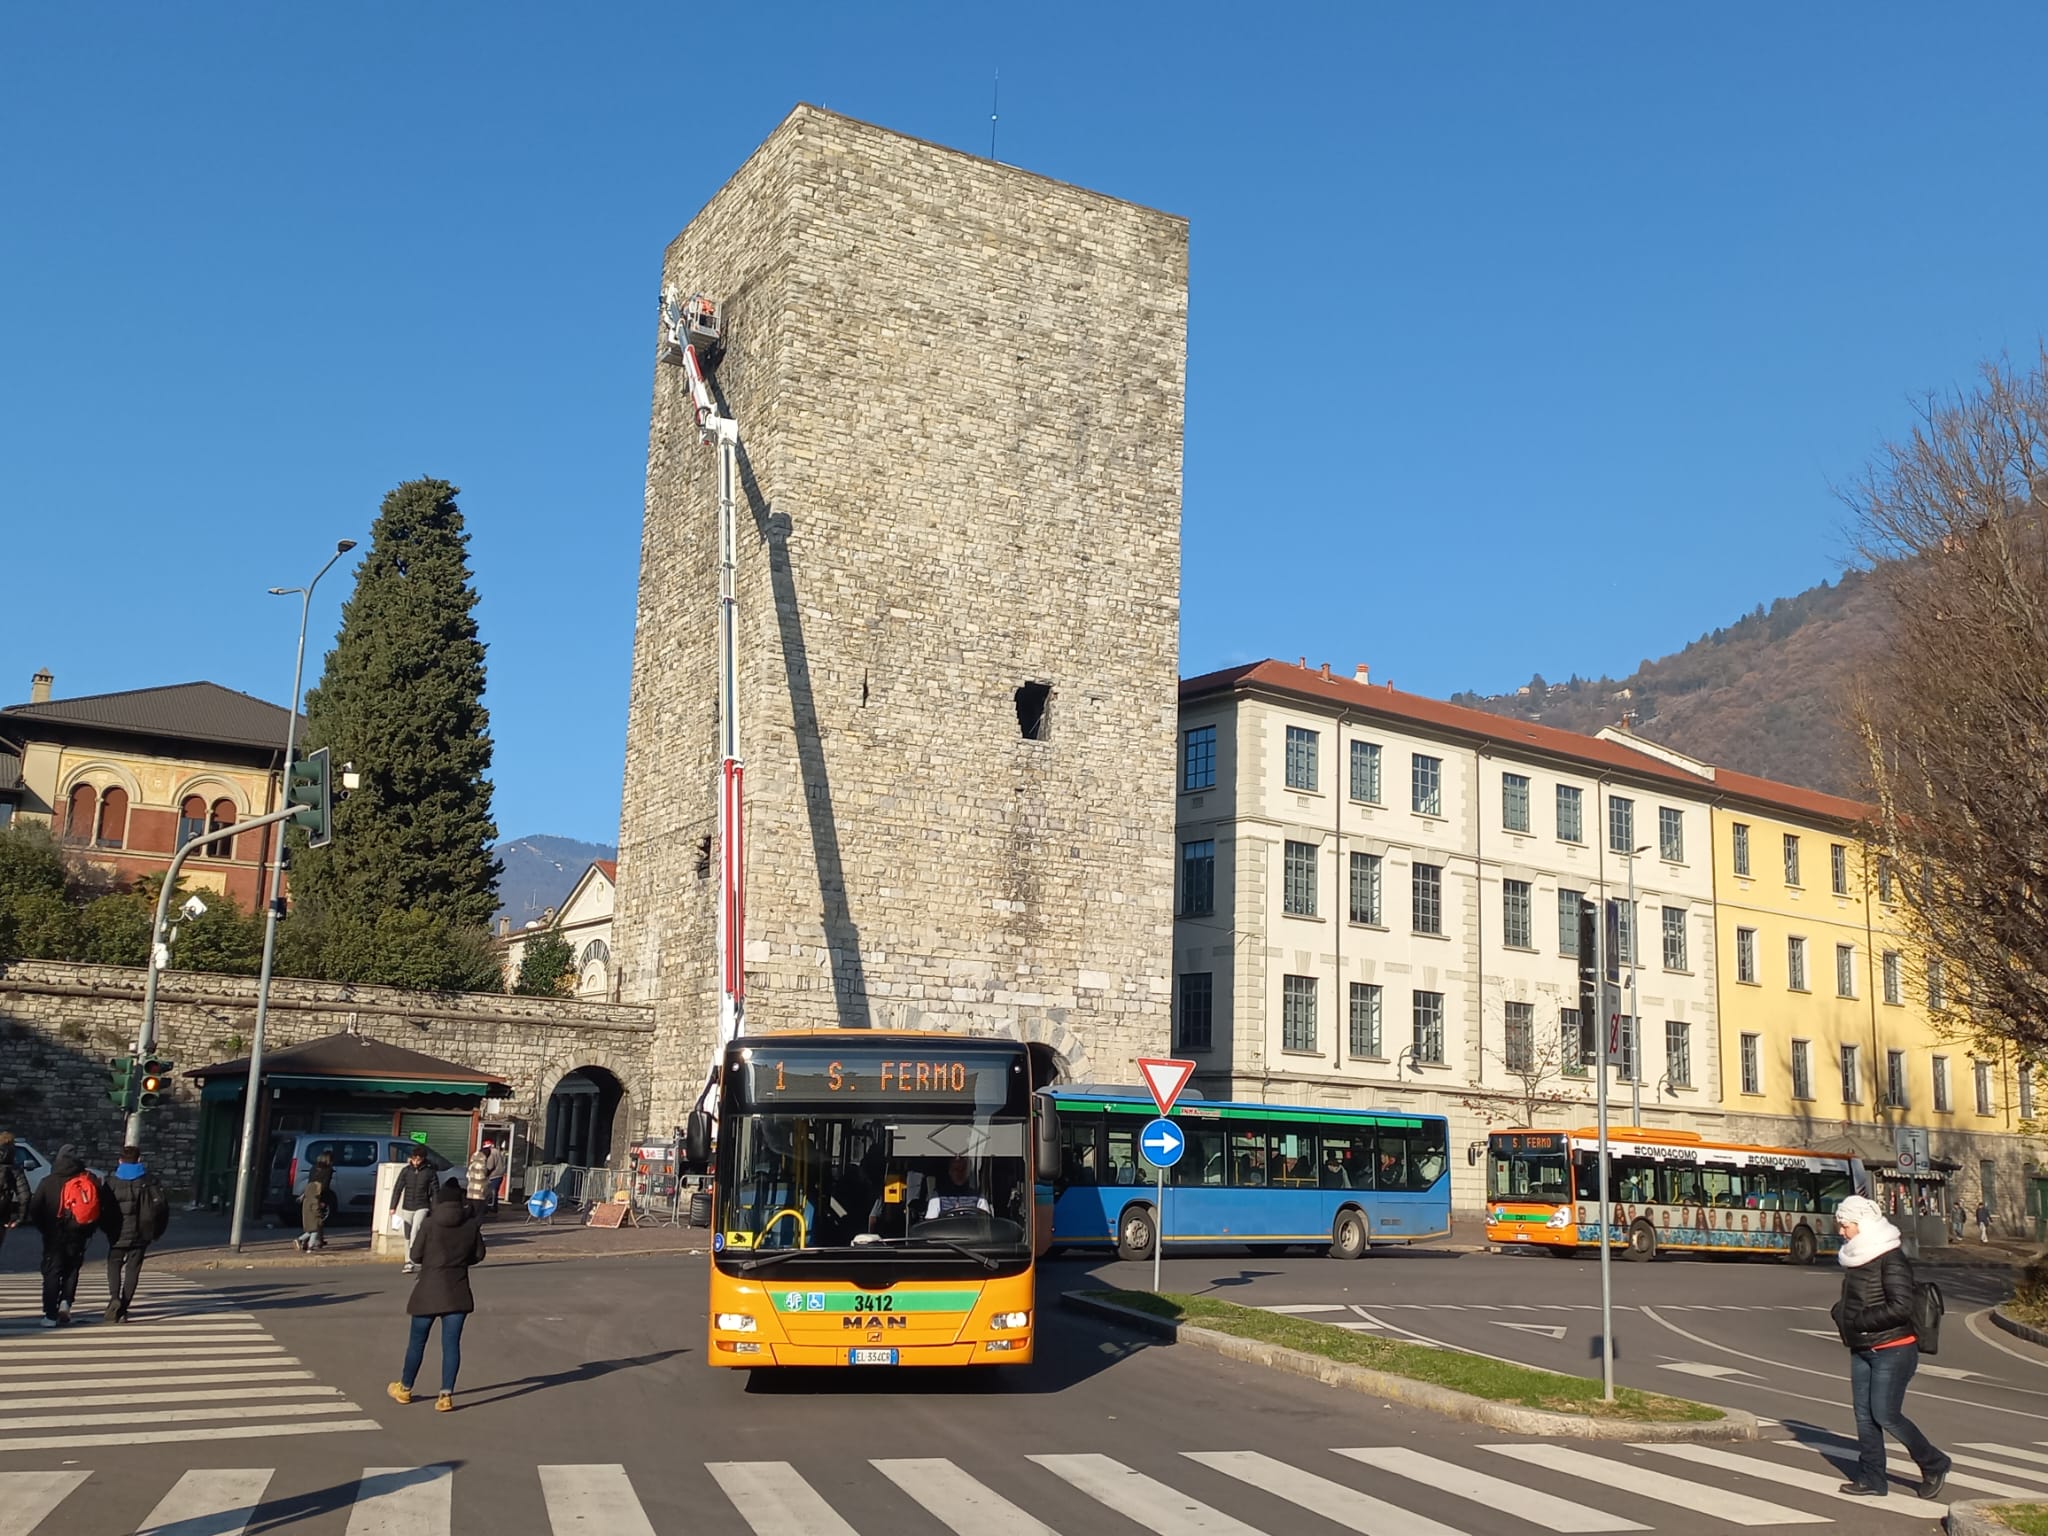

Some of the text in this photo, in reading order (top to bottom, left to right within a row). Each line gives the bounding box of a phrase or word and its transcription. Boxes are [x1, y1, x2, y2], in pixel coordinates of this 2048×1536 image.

[775, 1060, 966, 1091] 1 S. FERMO
[1526, 1136, 1552, 1148] FERMO
[1634, 1145, 1698, 1160] #COMO4COMO
[1748, 1154, 1806, 1168] #COMO4COMO
[855, 1295, 893, 1312] 3412
[843, 1316, 907, 1328] MAN
